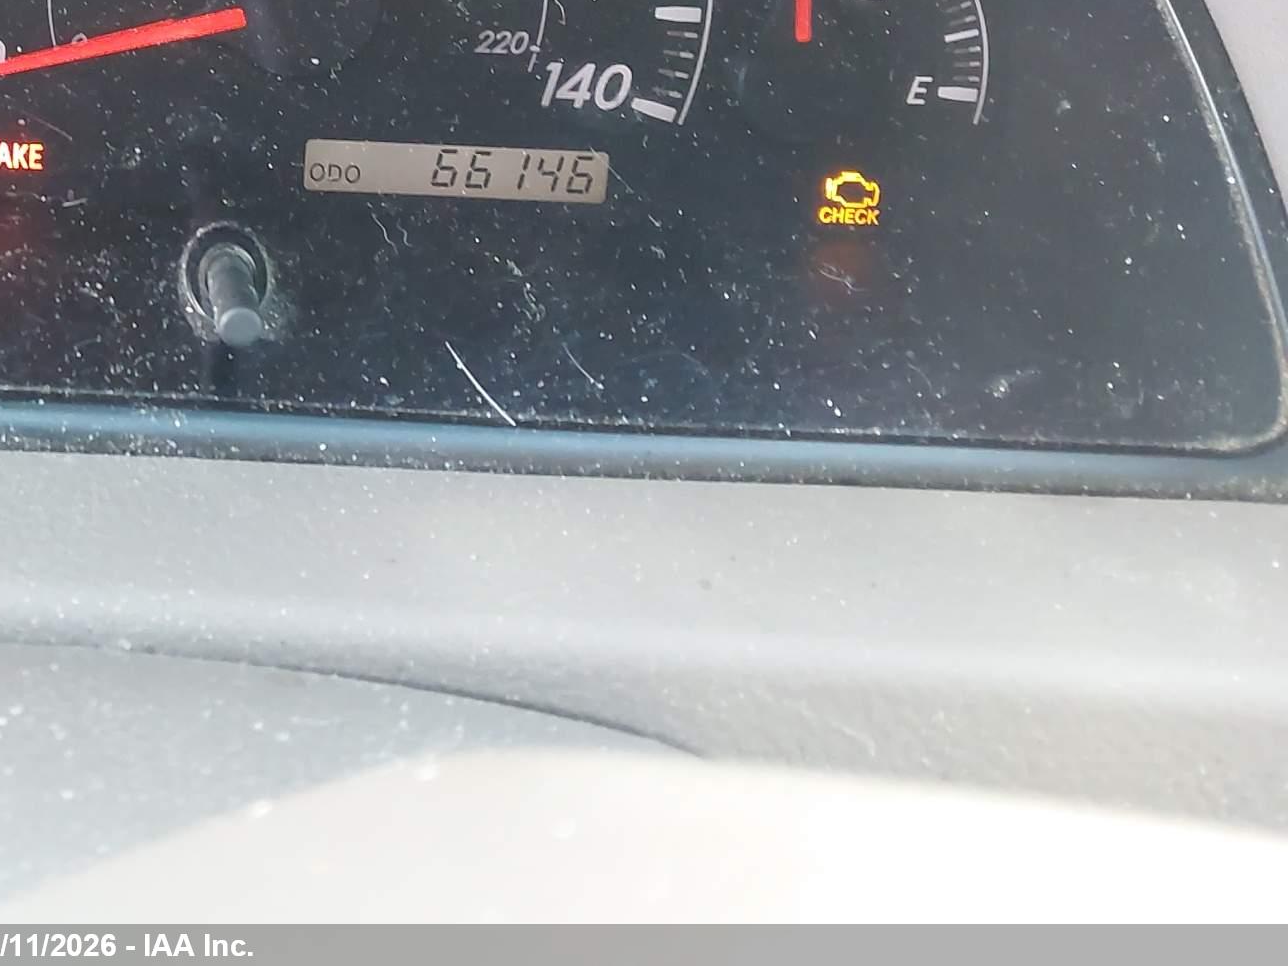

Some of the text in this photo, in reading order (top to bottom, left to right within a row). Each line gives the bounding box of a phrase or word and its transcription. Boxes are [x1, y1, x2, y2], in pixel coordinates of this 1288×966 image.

[474, 31, 529, 55] 220
[540, 62, 632, 110] 140
[906, 76, 933, 105] E
[309, 149, 594, 194] ODO 66146
[818, 207, 880, 225] CHECK
